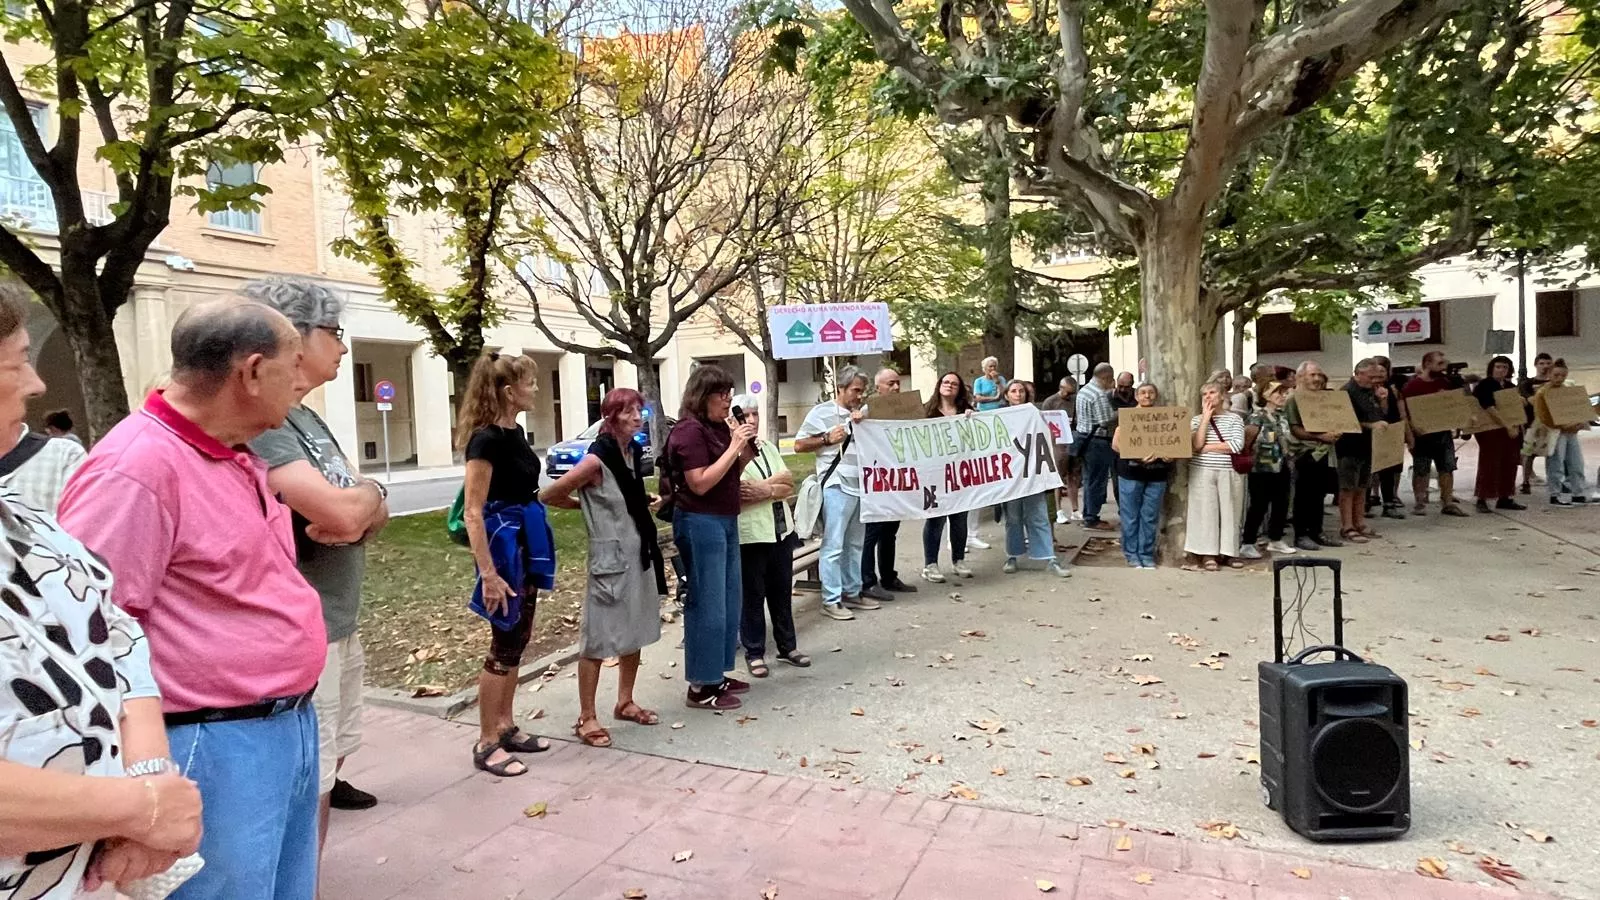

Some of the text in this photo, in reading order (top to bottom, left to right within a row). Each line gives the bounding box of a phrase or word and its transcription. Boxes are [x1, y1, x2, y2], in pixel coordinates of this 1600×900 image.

[885, 415, 1012, 463] VIVIENDA
[1129, 437, 1143, 447] NO
[1131, 424, 1138, 432] A
[1012, 432, 1056, 478] YA
[863, 453, 1012, 510] PÚBLICA DE ALQUILER
